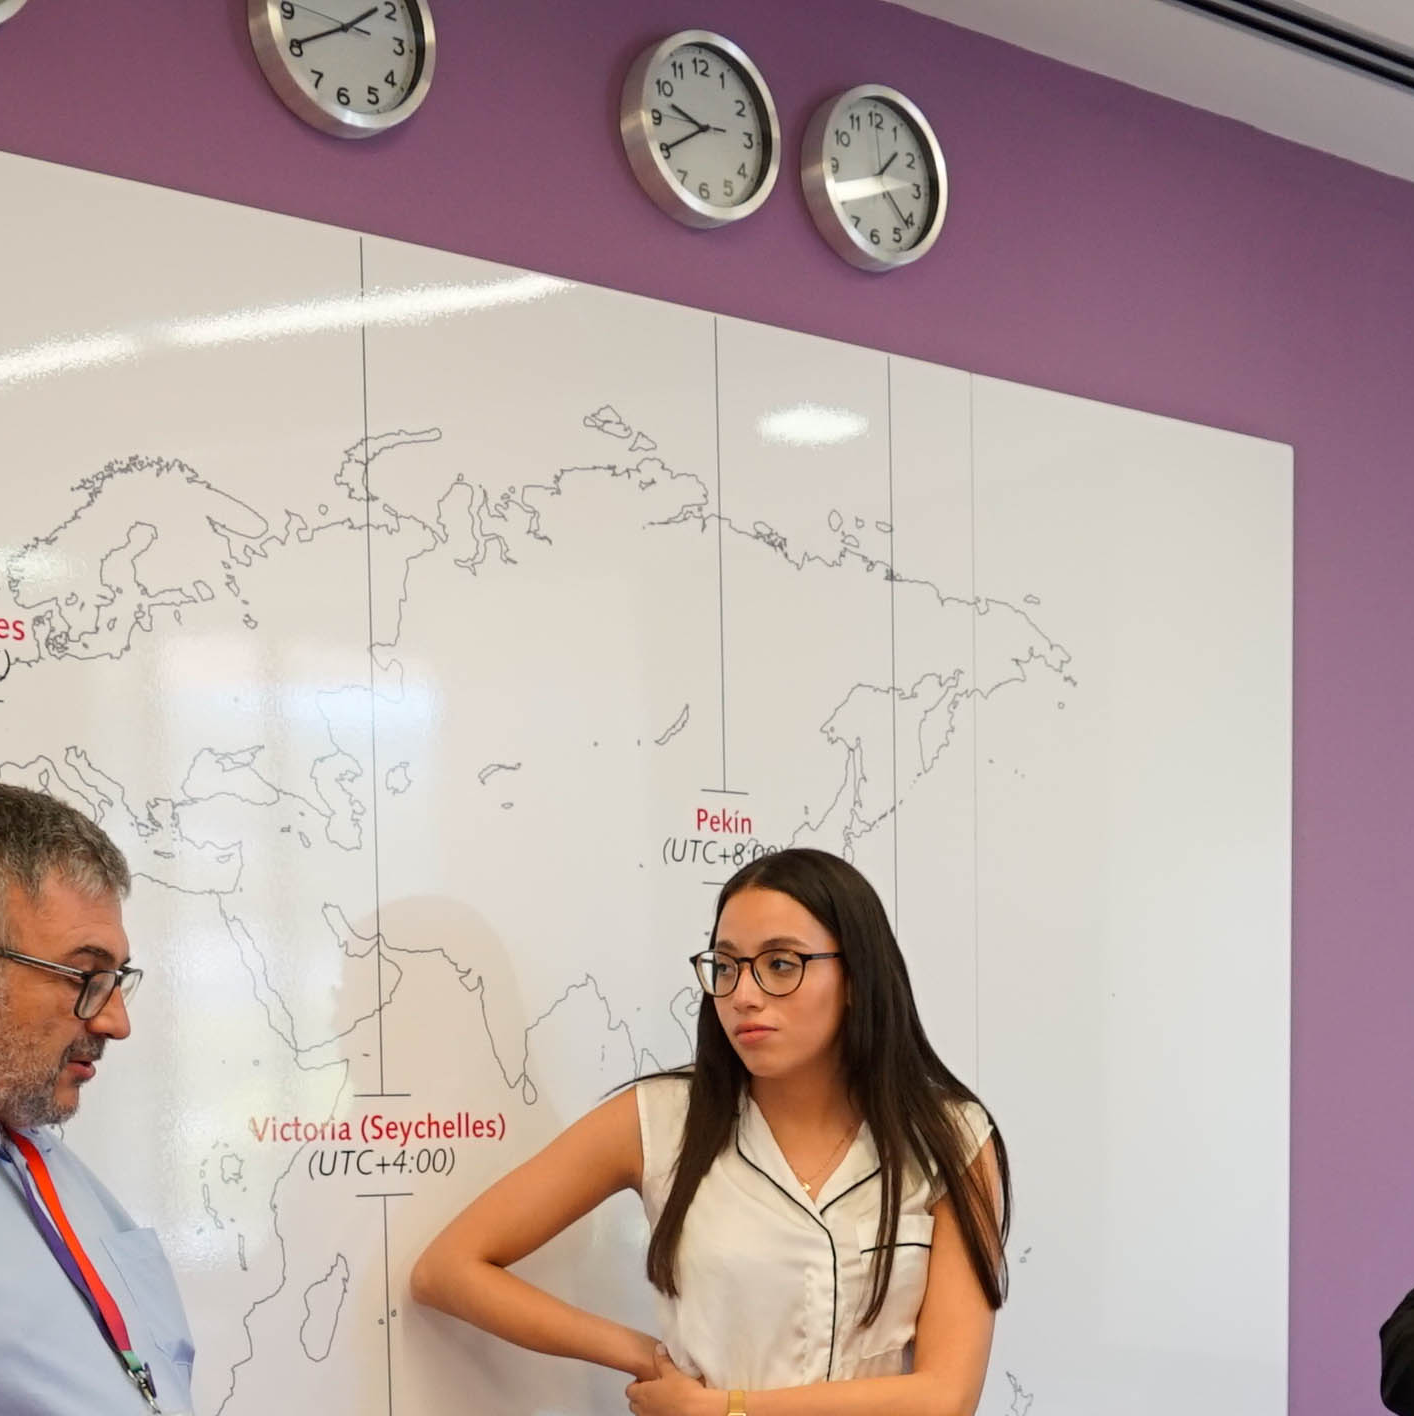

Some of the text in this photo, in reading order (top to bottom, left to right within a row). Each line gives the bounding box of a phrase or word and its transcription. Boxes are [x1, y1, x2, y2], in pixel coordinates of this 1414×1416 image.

[281, 1, 295, 20] 9
[384, 1, 398, 21] 2
[289, 38, 304, 57] 8
[392, 36, 405, 56] 3
[671, 61, 684, 80] 11
[692, 57, 710, 78] 12
[310, 69, 324, 89] 7
[384, 70, 397, 88] 4
[656, 78, 674, 97] 10
[719, 72, 726, 89] 1
[337, 87, 351, 106] 6
[367, 86, 380, 105] 5
[651, 108, 663, 126] 9
[735, 99, 746, 118] 2
[849, 114, 861, 132] 11
[868, 111, 884, 130] 12
[743, 131, 754, 150] 3
[834, 130, 851, 148] 10
[892, 126, 898, 142] 1
[659, 142, 671, 160] 8
[905, 152, 916, 170] 2
[677, 168, 688, 185] 7
[737, 162, 747, 179] 4
[698, 182, 710, 200] 6
[723, 180, 734, 197] 5
[912, 183, 922, 200] 3
[851, 215, 861, 228] 7
[870, 229, 881, 245] 6
[893, 227, 903, 243] 5
[250, 1112, 506, 1147] Victoria (Seychelles)
[308, 1147, 456, 1180] (UTC+4:00)
